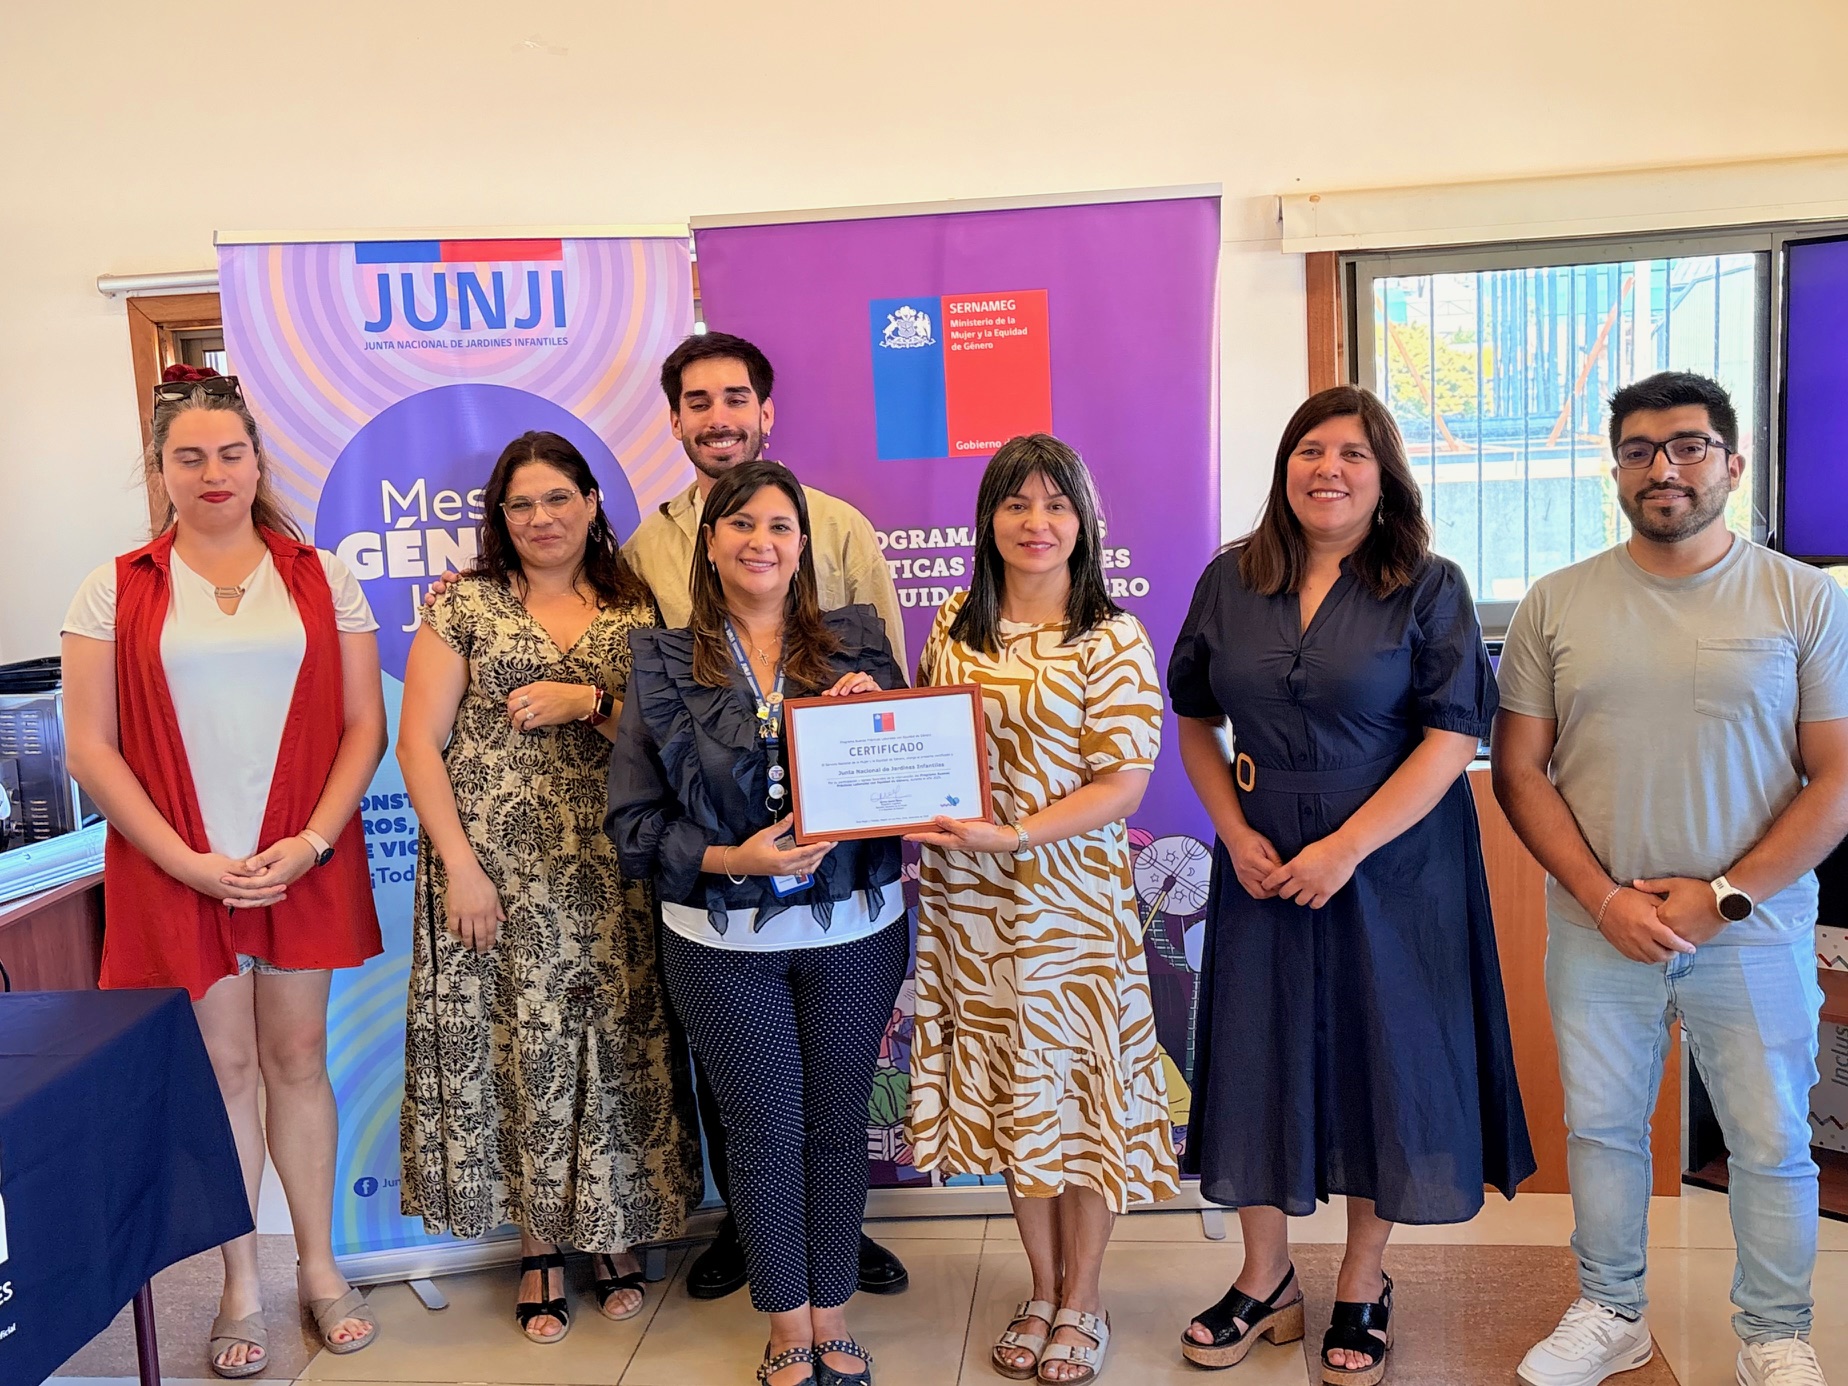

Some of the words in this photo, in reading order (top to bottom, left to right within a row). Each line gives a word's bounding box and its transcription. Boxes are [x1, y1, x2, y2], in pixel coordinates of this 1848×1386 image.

[364, 270, 567, 333] JUNJI
[949, 299, 1016, 314] SERNAMEG
[950, 317, 994, 328] Ministerio
[995, 316, 1006, 325] de
[1007, 316, 1016, 325] la
[950, 331, 976, 340] Mujer
[977, 331, 983, 340] y
[984, 329, 993, 338] la
[994, 326, 1028, 338] Equidad
[364, 341, 395, 351] JUNTA
[397, 340, 449, 349] NACIONAL
[450, 339, 464, 348] DE
[465, 338, 512, 348] JARDINES
[514, 337, 569, 347] INFANTILES
[951, 342, 962, 351] de
[963, 341, 994, 351] Género
[955, 439, 1002, 451] Gobierno
[381, 478, 487, 524] Mes
[849, 741, 924, 757] CERTIFICADO
